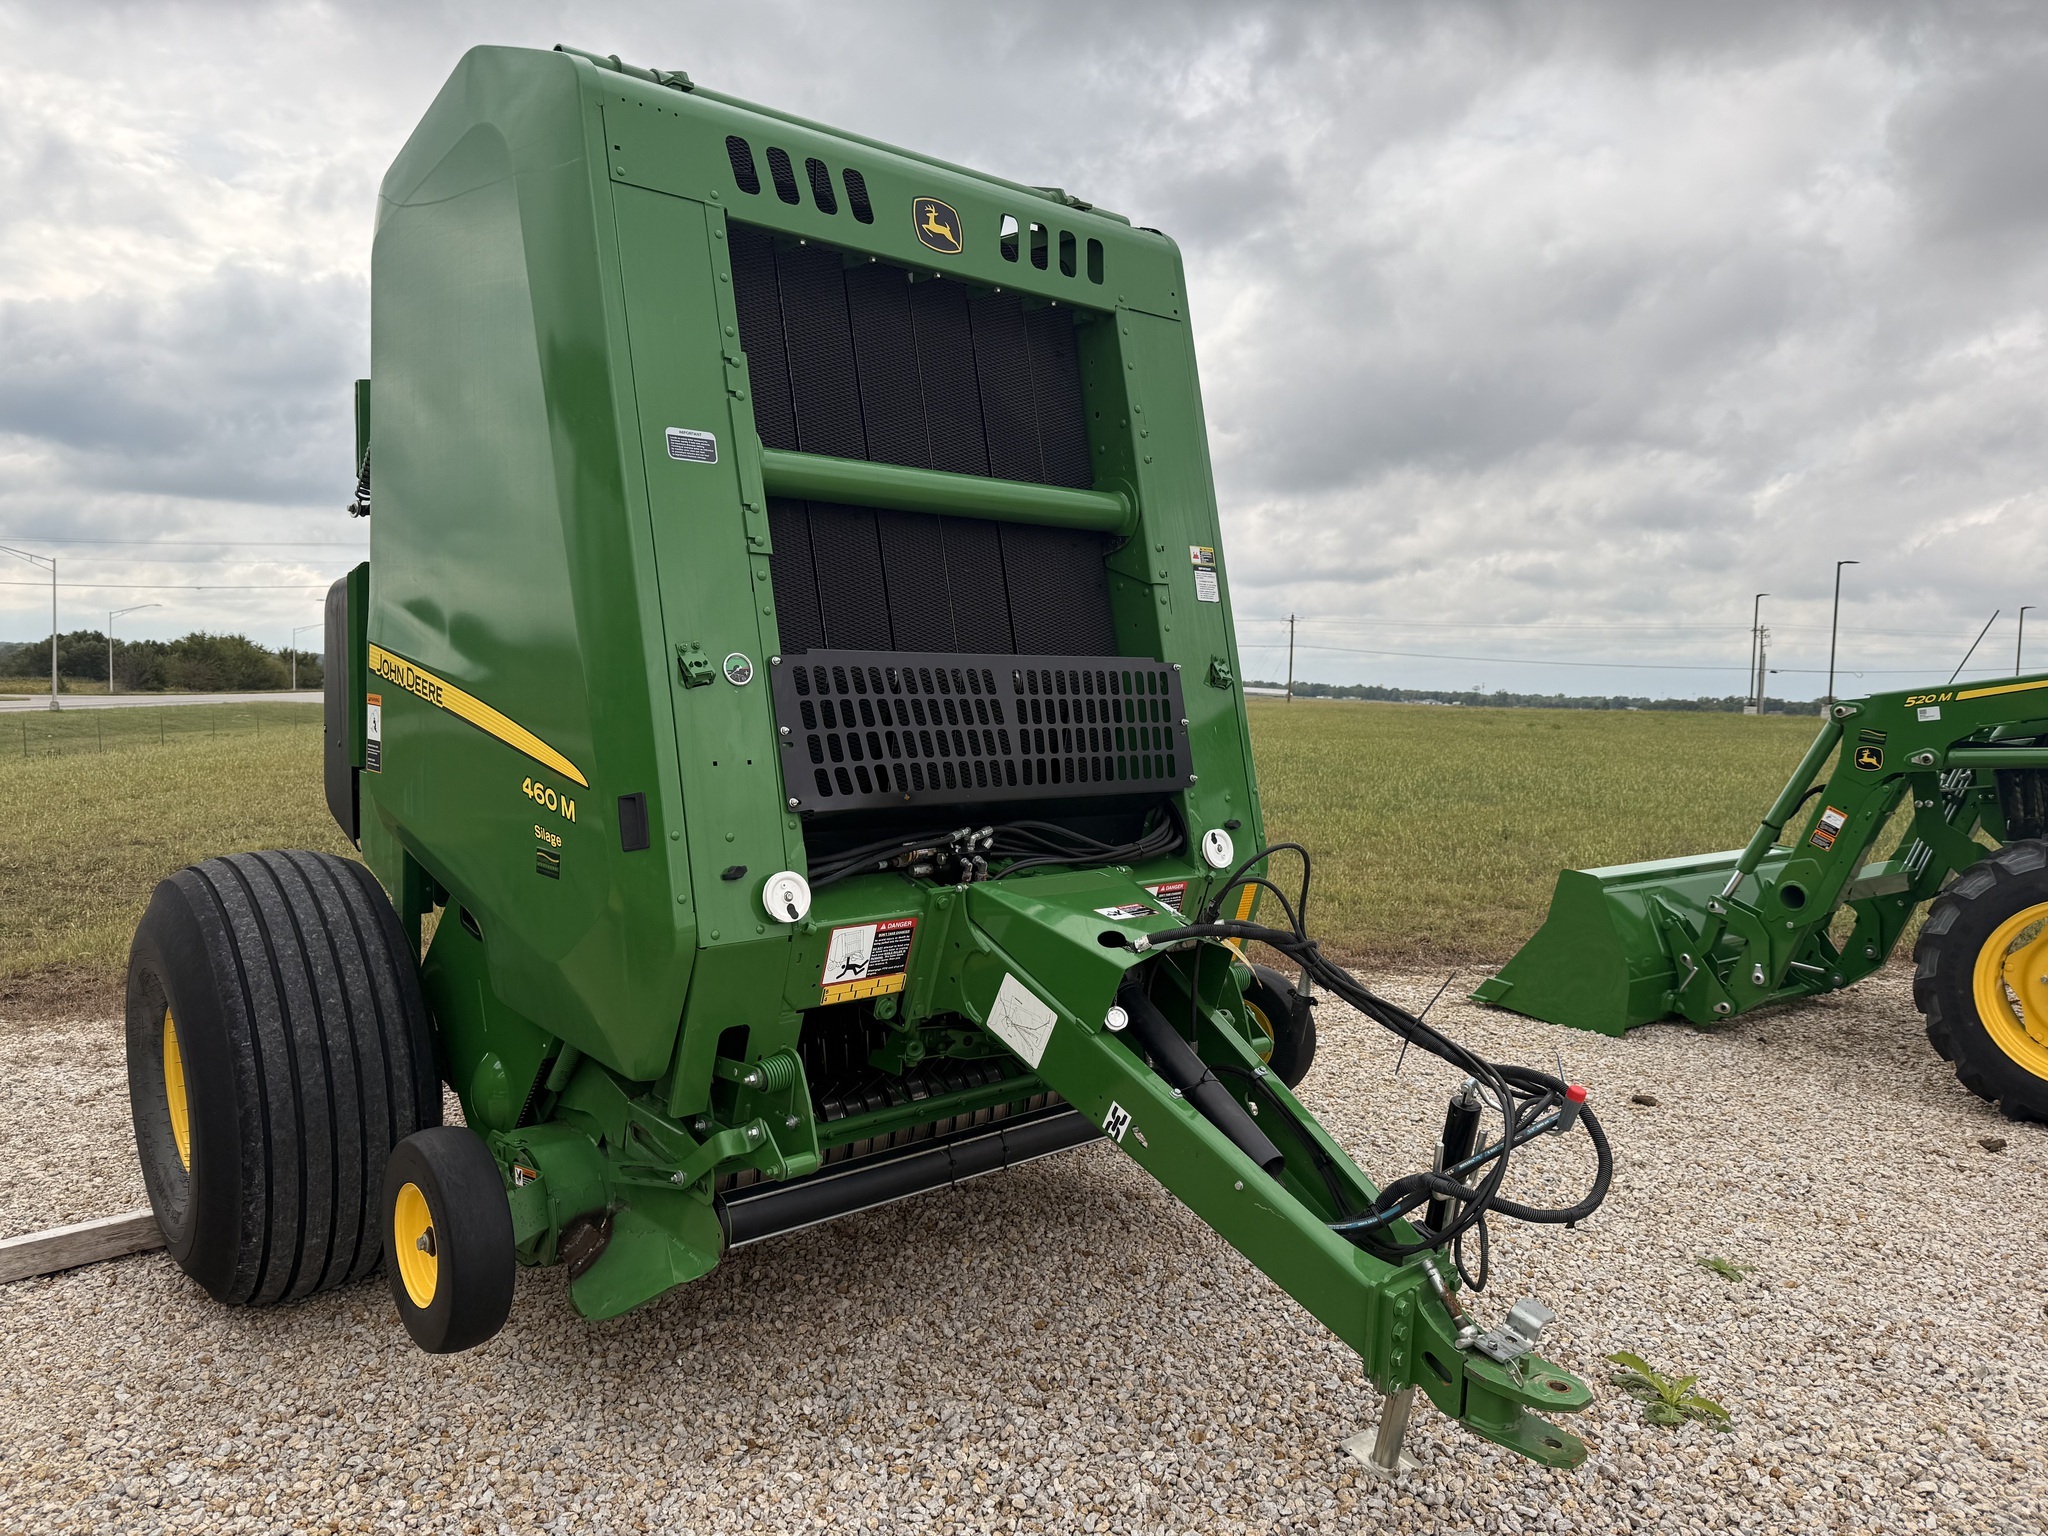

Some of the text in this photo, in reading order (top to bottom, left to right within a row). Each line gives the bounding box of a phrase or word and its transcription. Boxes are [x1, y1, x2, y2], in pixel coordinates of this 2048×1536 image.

[377, 653, 443, 705] JOHN DEERE
[1903, 692, 1953, 707] 520 M
[522, 776, 576, 823] 460 M
[534, 824, 562, 848] Silage
[1166, 883, 1184, 891] DANGER
[887, 921, 912, 929] DANGER
